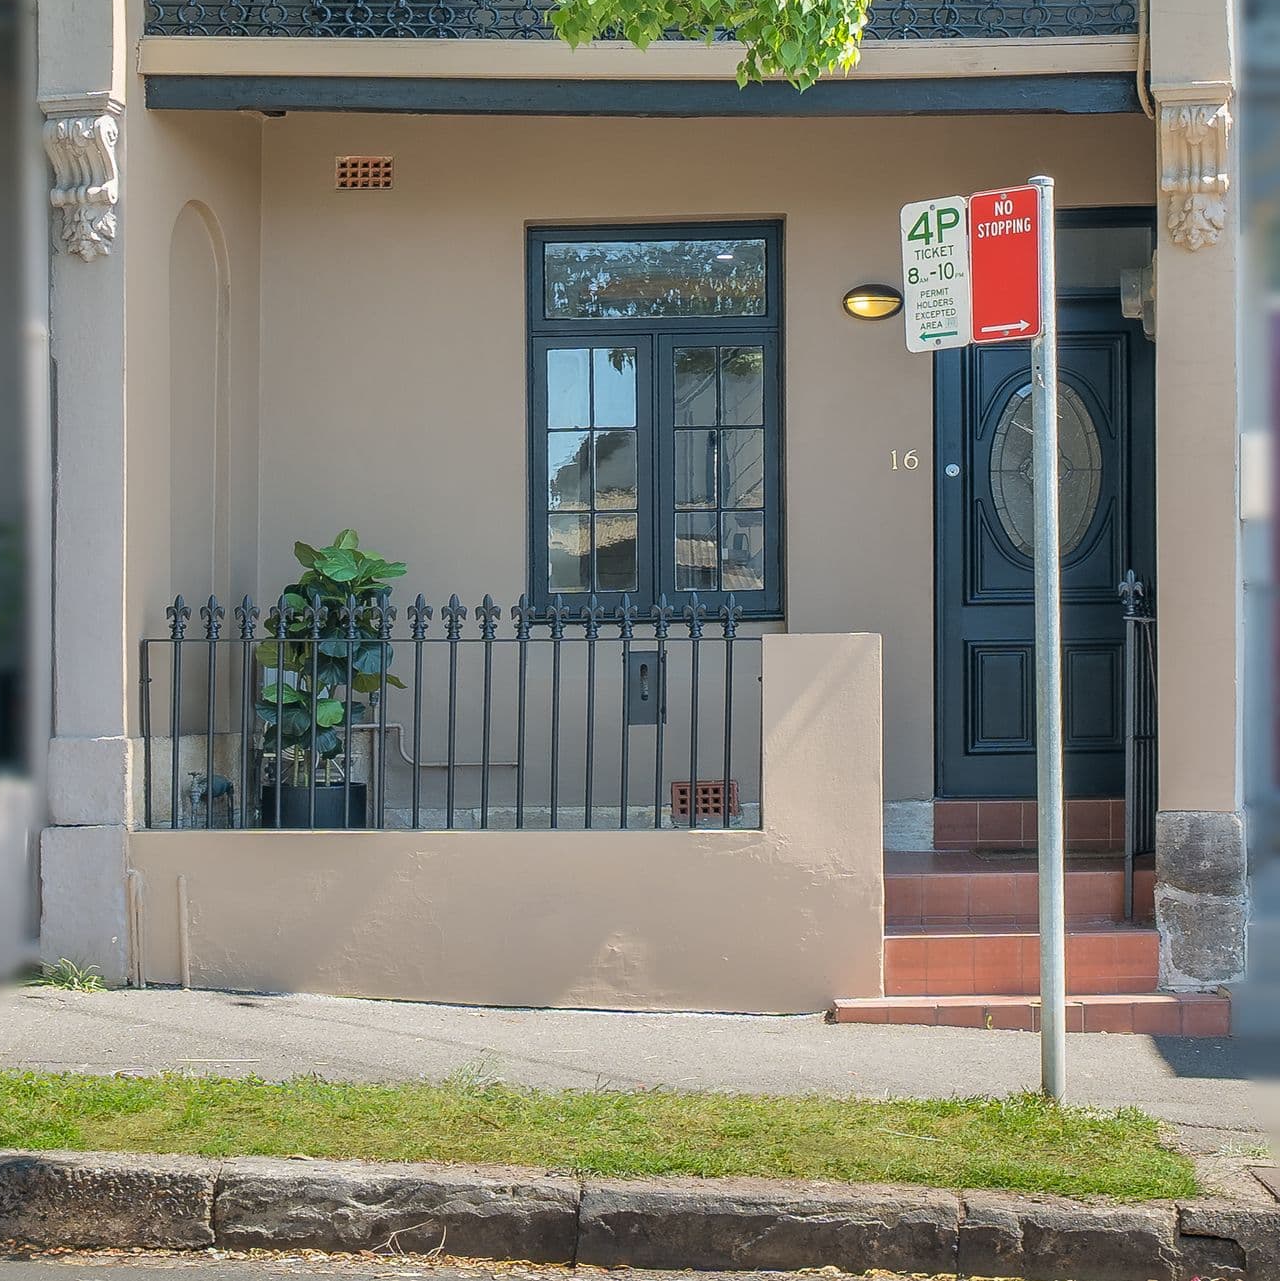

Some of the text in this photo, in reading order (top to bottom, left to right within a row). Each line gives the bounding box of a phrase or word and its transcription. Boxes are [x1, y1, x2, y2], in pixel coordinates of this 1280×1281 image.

[994, 200, 1013, 217] NO
[907, 207, 960, 246] 4P
[977, 217, 1032, 239] STOPPING
[914, 245, 955, 261] TICKET
[920, 287, 949, 299] PERMIT
[916, 298, 954, 310] HOLDERS
[915, 308, 957, 321] EXCEPTED
[920, 321, 943, 331] AREA
[890, 448, 920, 471] 16
